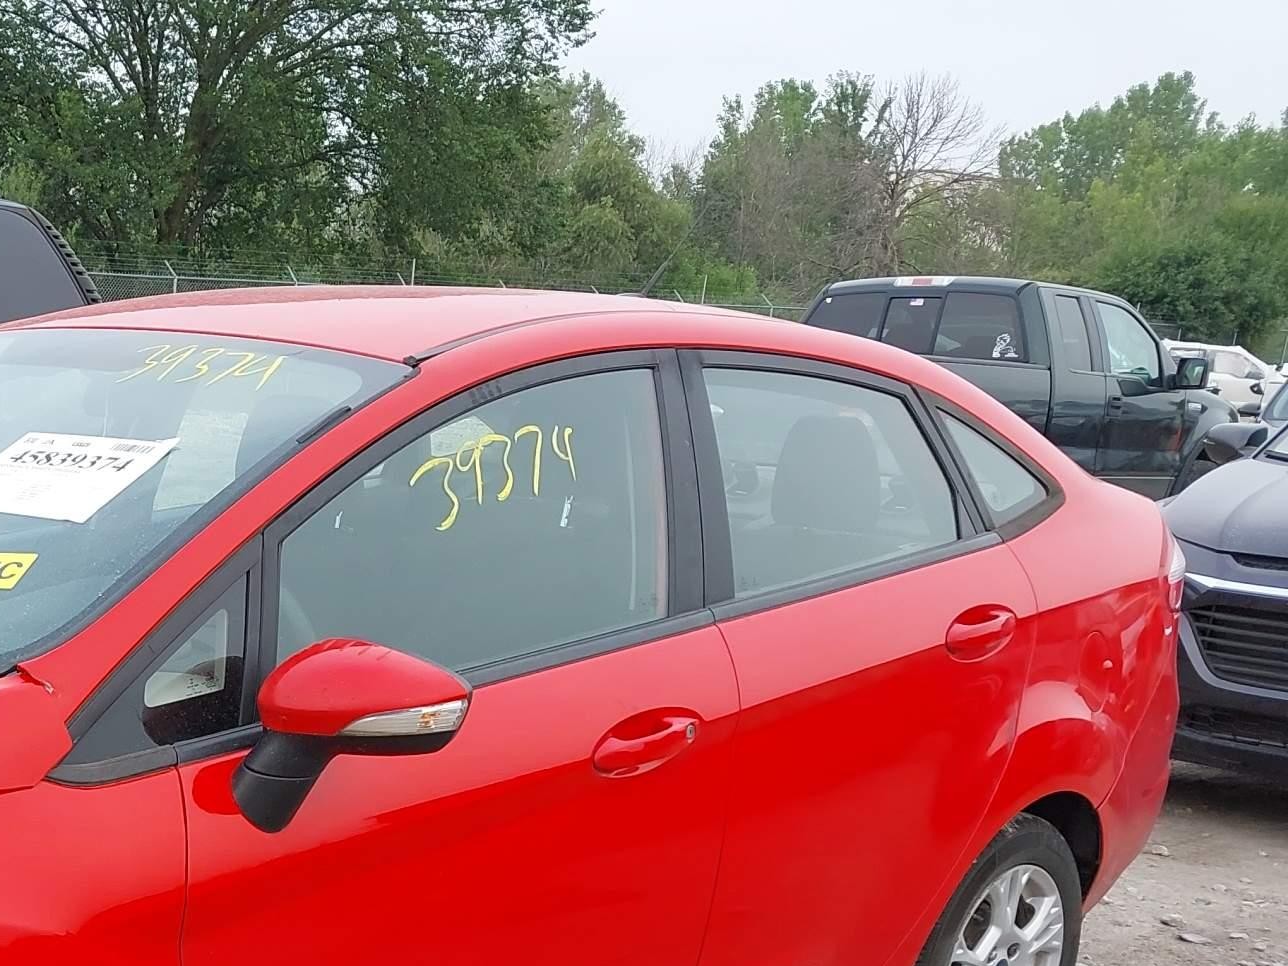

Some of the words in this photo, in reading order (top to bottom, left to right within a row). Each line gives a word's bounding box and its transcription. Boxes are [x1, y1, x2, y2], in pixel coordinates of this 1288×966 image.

[114, 344, 289, 392] 39374
[10, 449, 135, 473] 45839374
[409, 424, 577, 531] 39374
